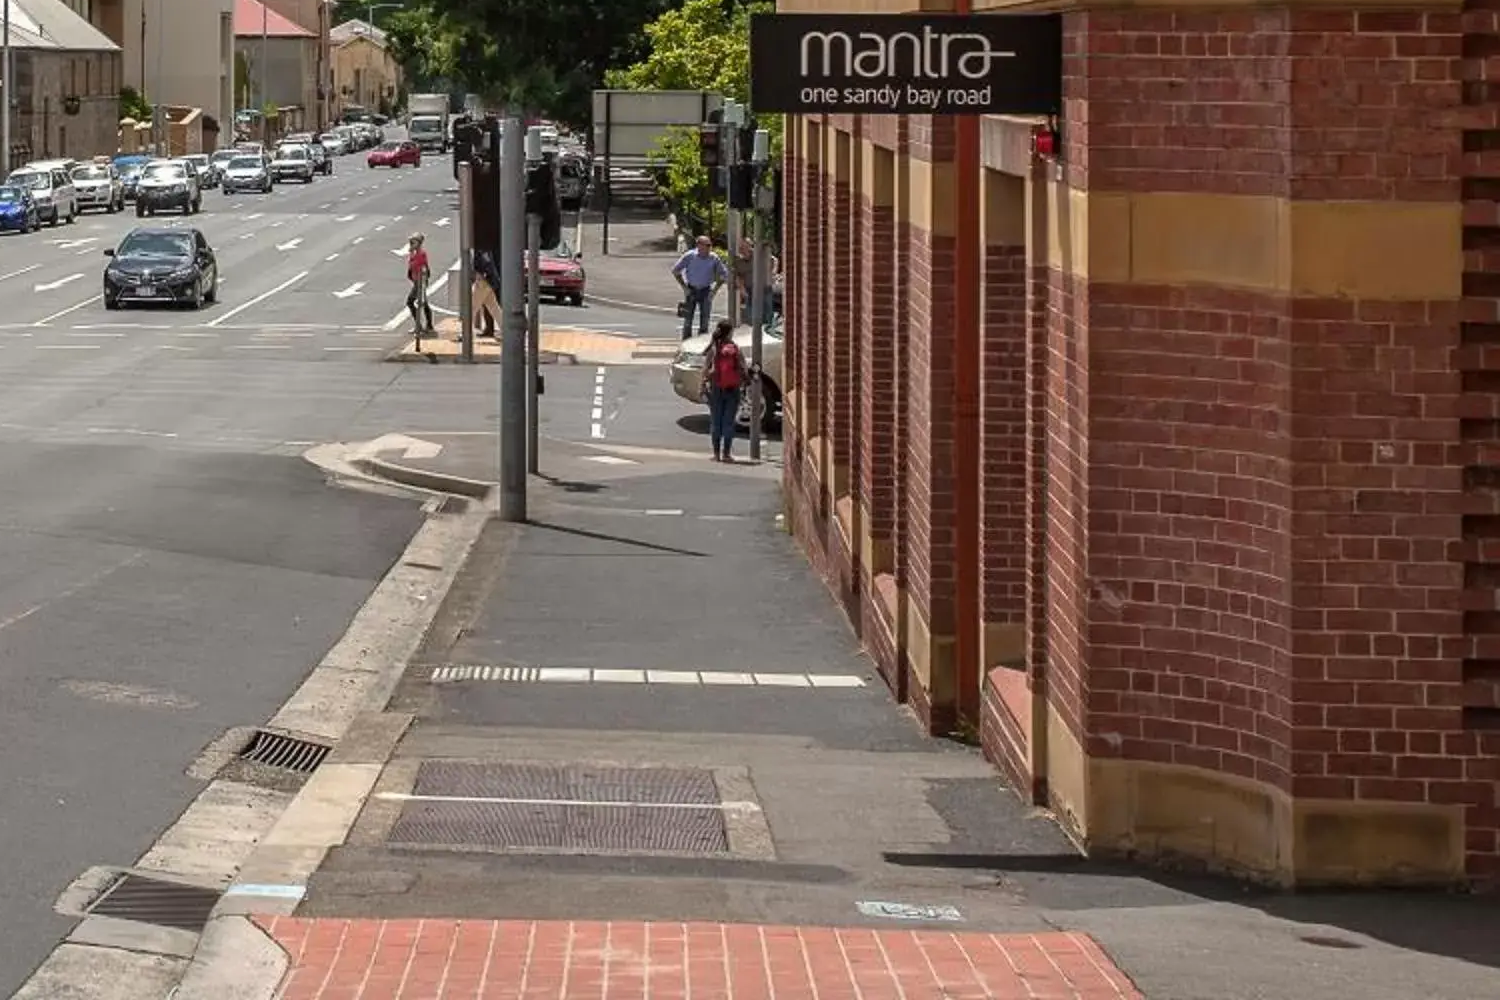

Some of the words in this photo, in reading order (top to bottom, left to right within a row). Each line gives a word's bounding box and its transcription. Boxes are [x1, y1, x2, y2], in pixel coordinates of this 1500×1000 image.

[801, 25, 1016, 79] mantra
[801, 87, 839, 103] one
[843, 84, 900, 109] sandy
[906, 85, 941, 109] bay
[947, 86, 991, 105] road
